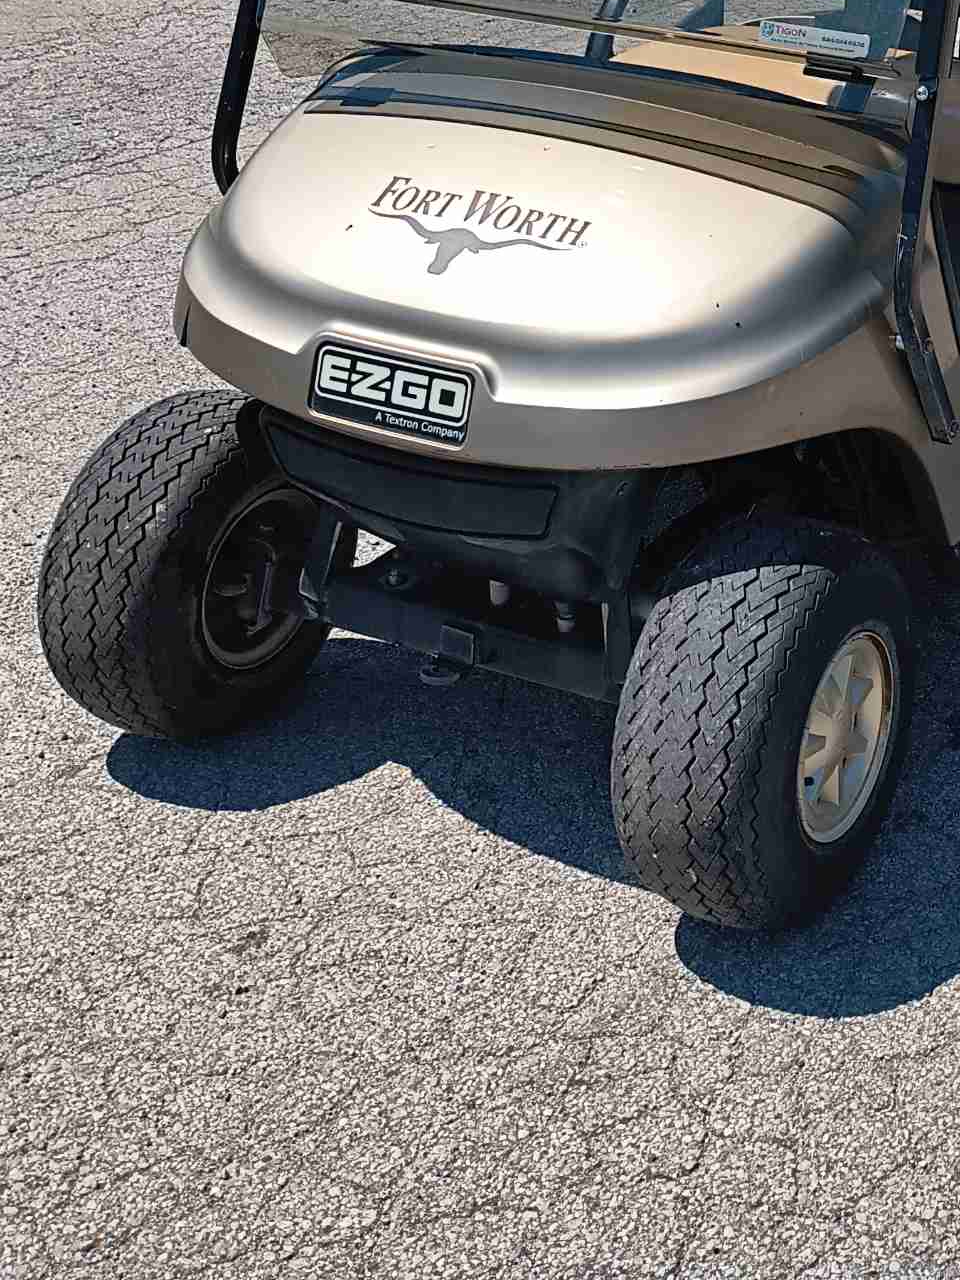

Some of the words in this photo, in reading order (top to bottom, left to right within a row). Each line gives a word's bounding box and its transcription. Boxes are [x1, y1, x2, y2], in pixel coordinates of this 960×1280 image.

[370, 176, 463, 217] FORT
[375, 411, 382, 421] A
[385, 413, 419, 431] Textron
[421, 422, 465, 440] Company
